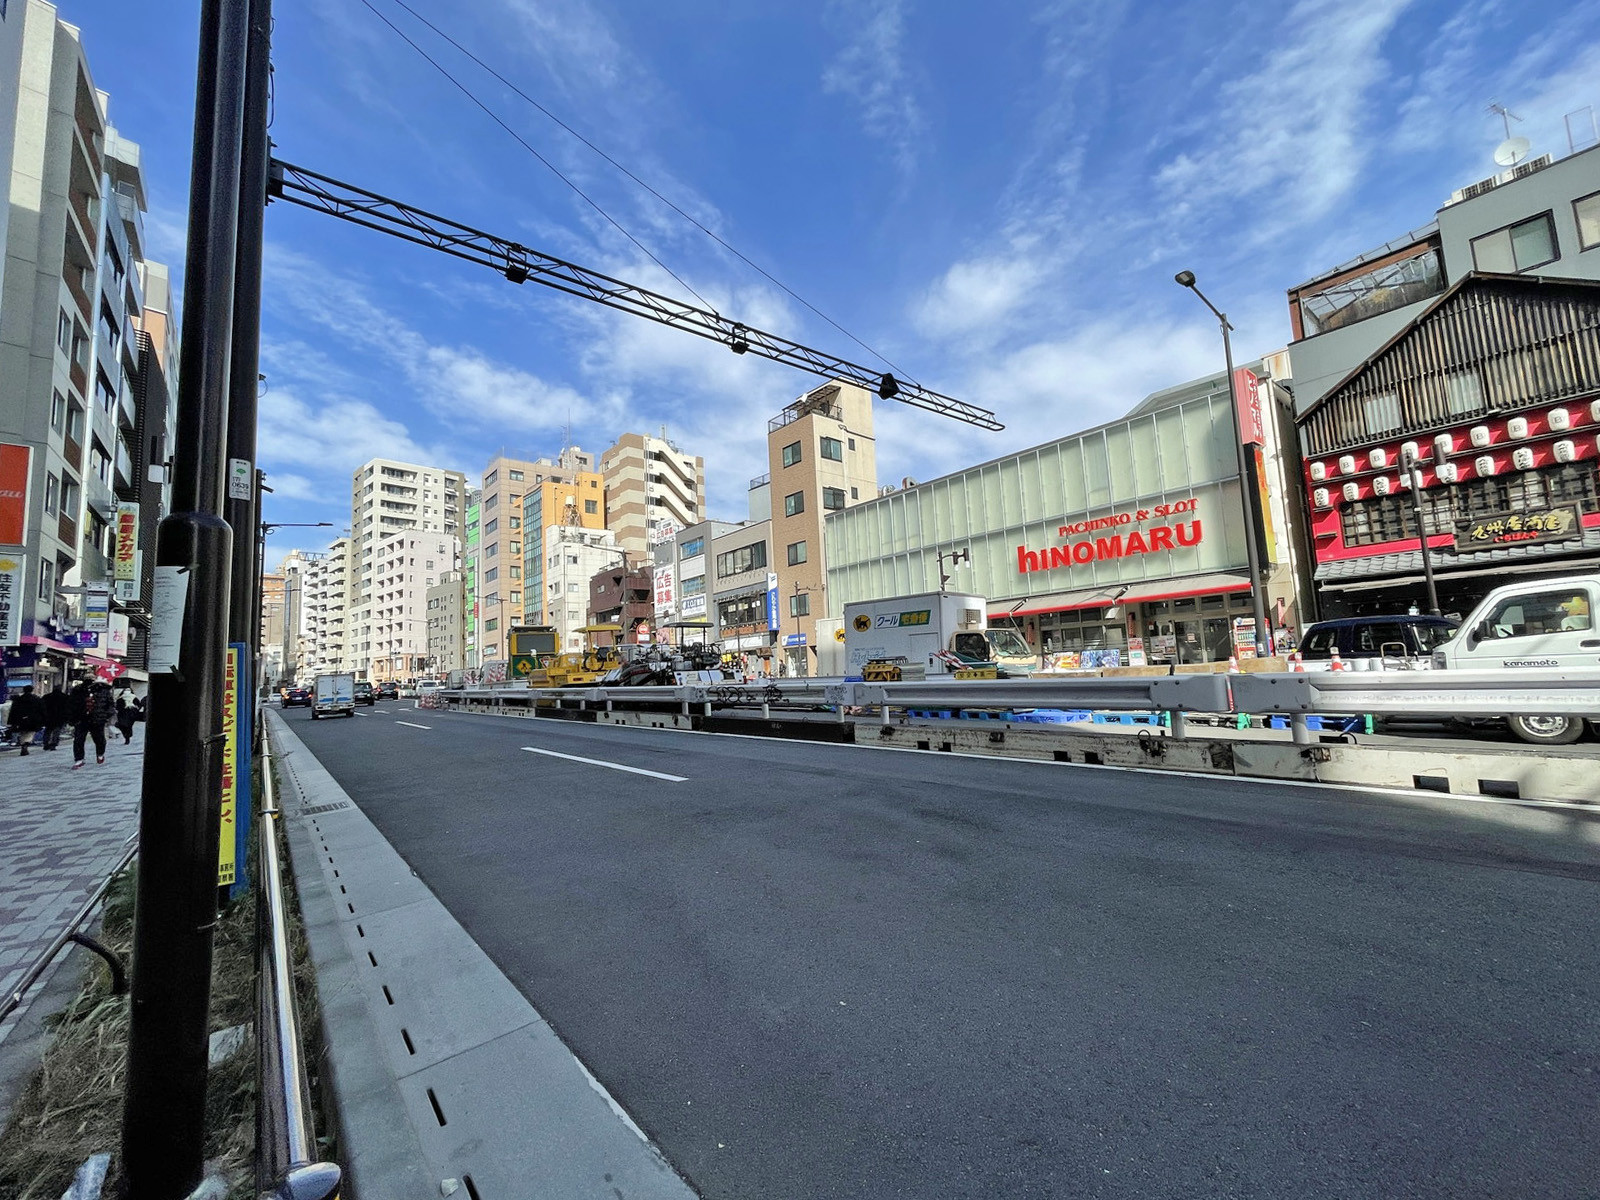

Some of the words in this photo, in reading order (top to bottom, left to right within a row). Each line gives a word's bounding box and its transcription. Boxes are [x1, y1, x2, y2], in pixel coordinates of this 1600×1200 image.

[1058, 513, 1131, 537] PACHINKO
[1135, 509, 1149, 521] &
[1154, 498, 1198, 518] SLOT
[656, 573, 672, 589] 広告
[876, 616, 899, 627] クール
[1503, 660, 1559, 668] kanamoto
